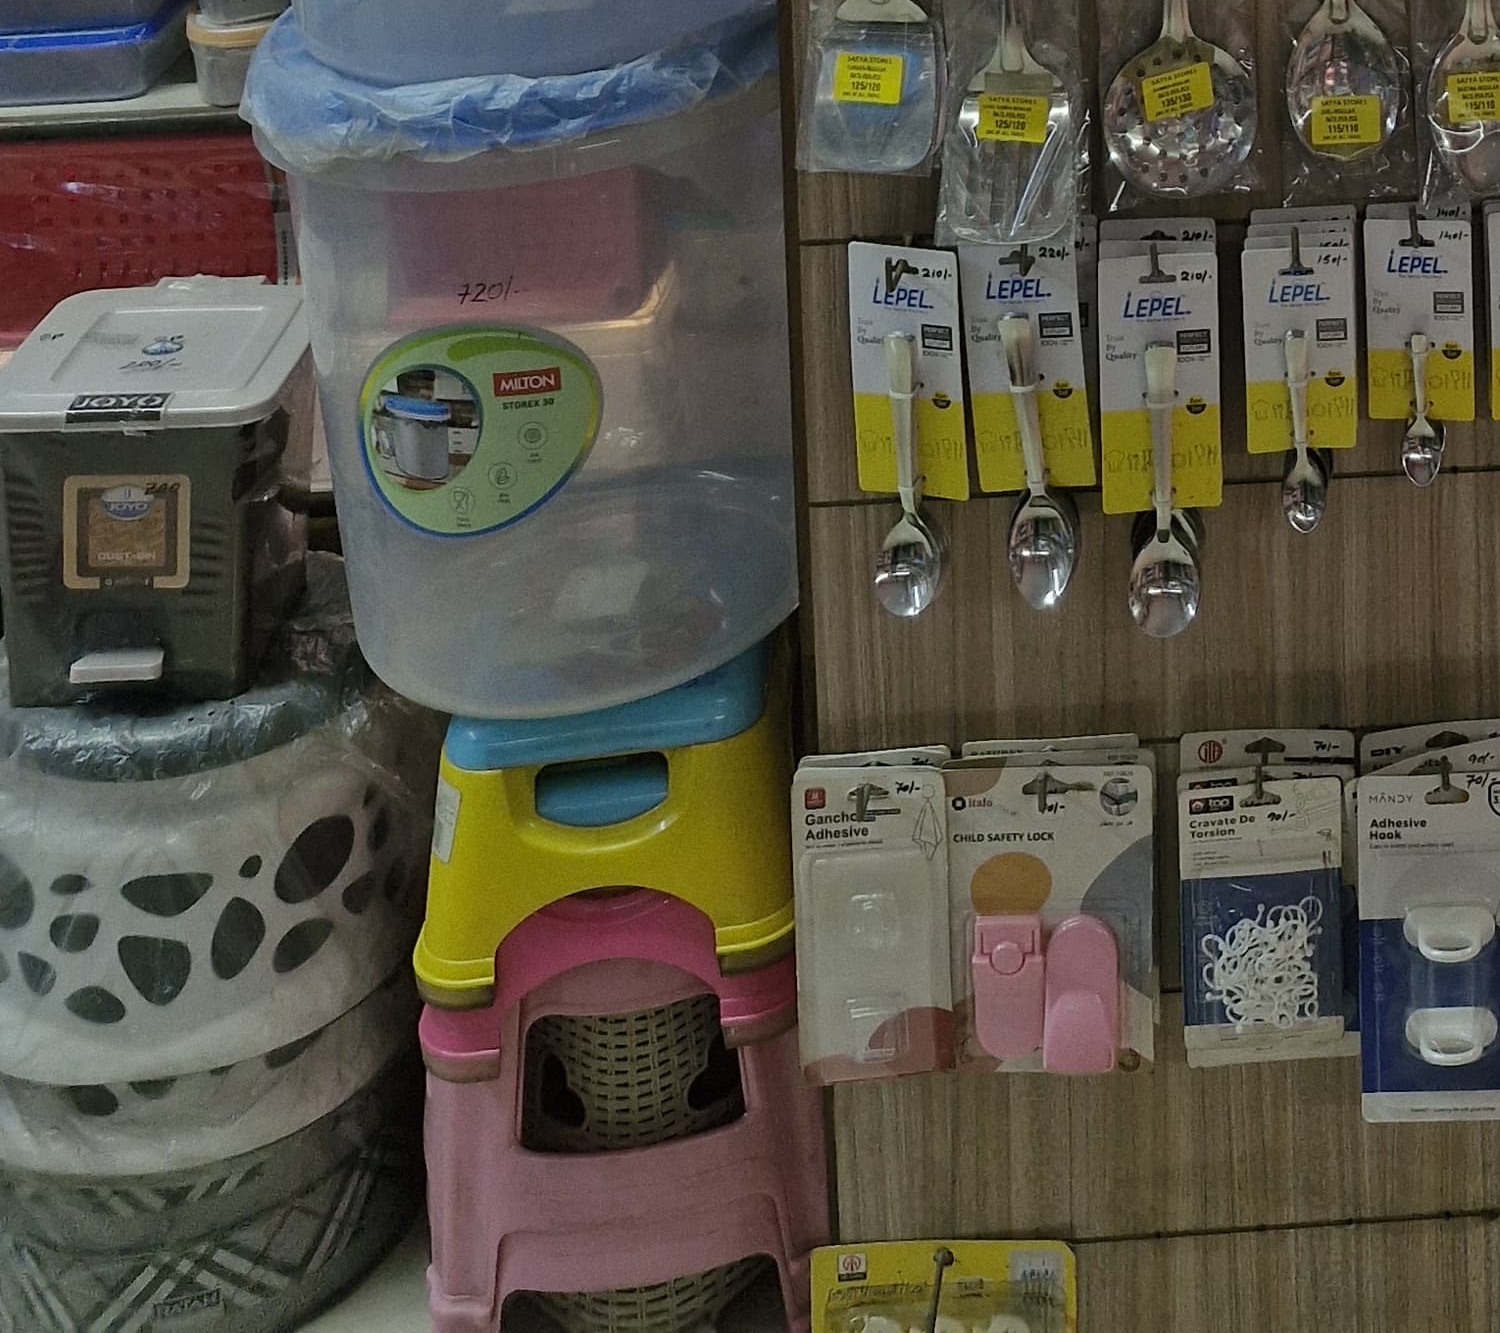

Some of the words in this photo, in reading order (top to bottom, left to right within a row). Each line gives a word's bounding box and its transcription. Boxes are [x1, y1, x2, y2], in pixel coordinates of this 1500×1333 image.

[851, 81, 881, 92] 125/120
[995, 120, 1026, 130] 125/120
[1328, 124, 1359, 133] 115/110
[1440, 230, 1469, 241] 140/-
[1038, 246, 1070, 259] 220/-
[1317, 254, 1348, 266] 150/-
[1387, 250, 1448, 274] LEPEL
[922, 268, 952, 281] 210/-
[1181, 270, 1213, 283] 210/-
[458, 279, 529, 305] 720/-
[985, 274, 1052, 300] LEPEL
[1268, 280, 1331, 303] LEPEL
[1123, 292, 1192, 320] LEPEL
[499, 375, 555, 393] MILTON
[76, 395, 164, 409] JOYO
[502, 400, 540, 410] STOREX
[109, 501, 148, 512] JOYO
[1465, 773, 1497, 787] 70/-
[896, 782, 921, 794] 70/-
[968, 797, 993, 808] italo
[1189, 817, 1237, 829] Cravate
[1239, 814, 1256, 824] De
[1370, 818, 1427, 829] Adhesive
[805, 826, 869, 840] Adhesive
[954, 832, 984, 843] CHILD
[987, 832, 1024, 843] SAFETY
[1026, 831, 1055, 842] LOCK
[1189, 827, 1236, 839] Torsion
[1370, 830, 1401, 841] Hook
